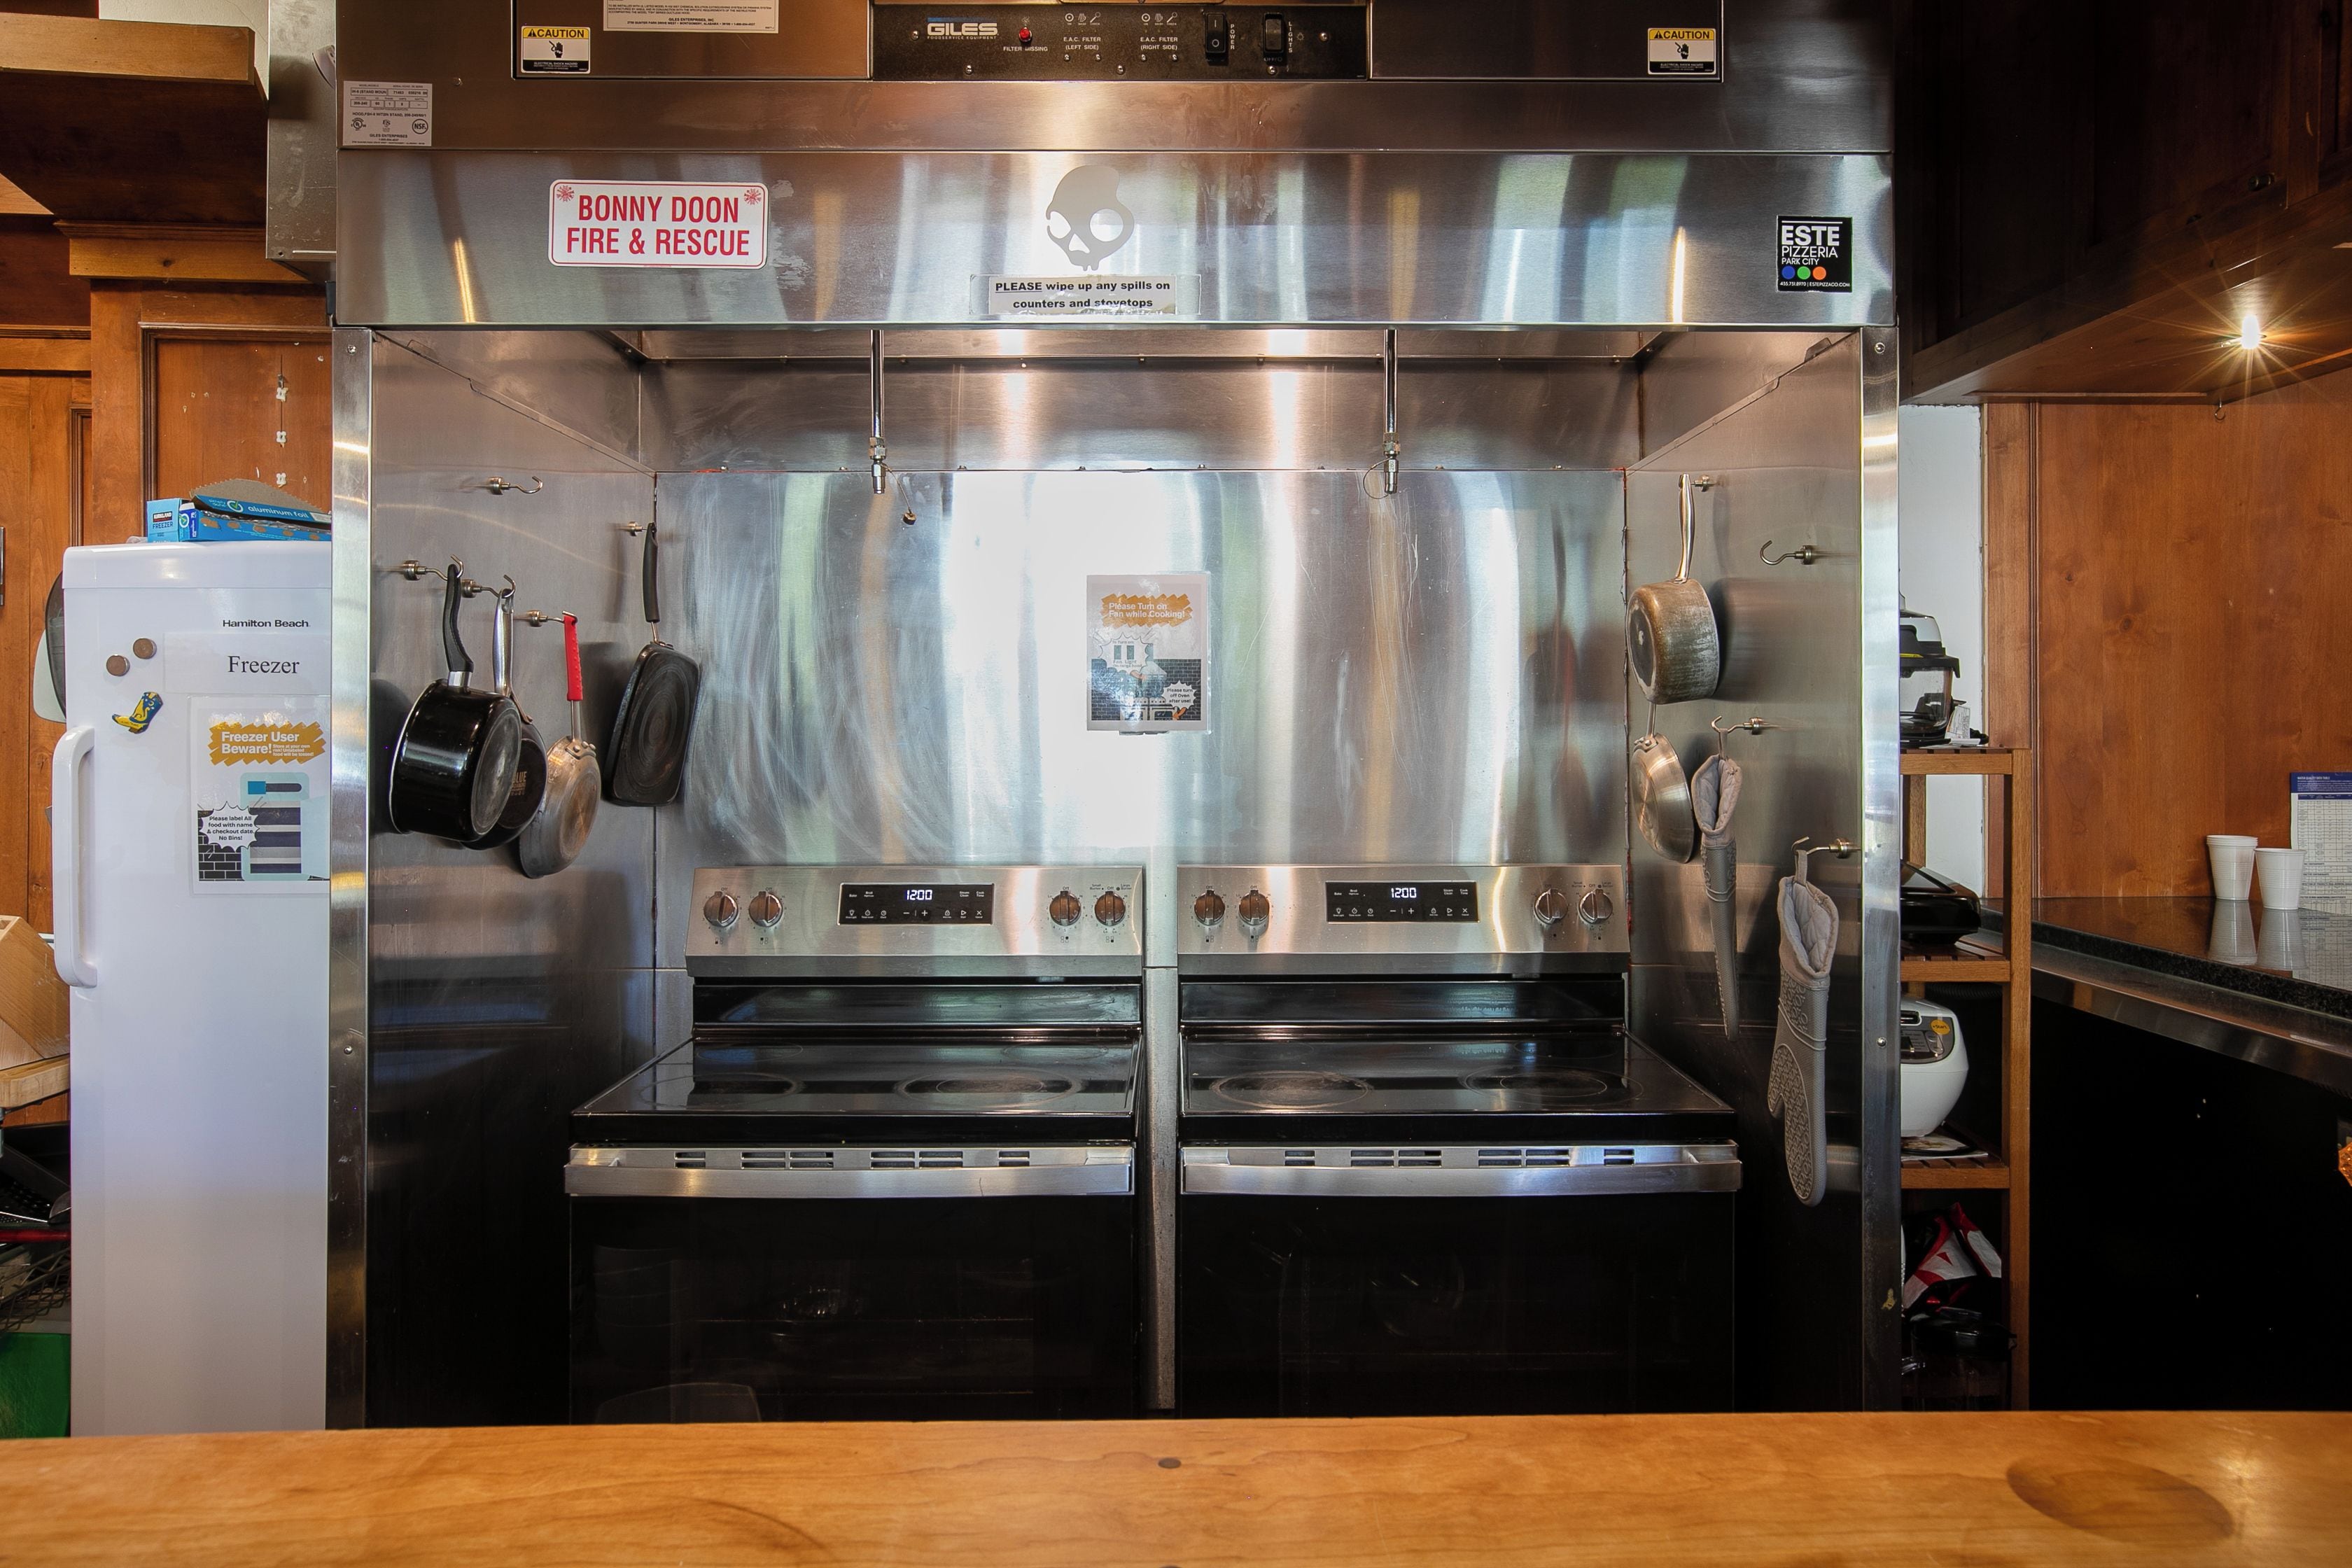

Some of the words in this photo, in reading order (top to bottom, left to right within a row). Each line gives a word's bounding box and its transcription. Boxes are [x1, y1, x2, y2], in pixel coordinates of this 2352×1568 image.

[537, 29, 584, 38] CAUTION
[927, 23, 997, 35] GILES
[579, 195, 662, 222] BONNY
[671, 196, 738, 223] DOON
[1782, 225, 1840, 246] ESTE
[567, 227, 620, 253] FIRE
[629, 228, 645, 254] &
[656, 229, 750, 255] RESCUE
[1782, 246, 1837, 258] PIZZERIA
[995, 282, 1042, 291] PLEASE
[1046, 282, 1074, 291] wipe
[1121, 281, 1152, 290] spills
[1013, 300, 1065, 308] counters
[1069, 299, 1091, 307] and
[1094, 300, 1153, 308] stovetops
[248, 506, 293, 516] aluminum
[1149, 610, 1185, 619] Cooking!
[227, 656, 300, 673] Freezer
[222, 732, 268, 742] Freezer
[271, 732, 300, 742] User
[222, 744, 272, 754] Beware!
